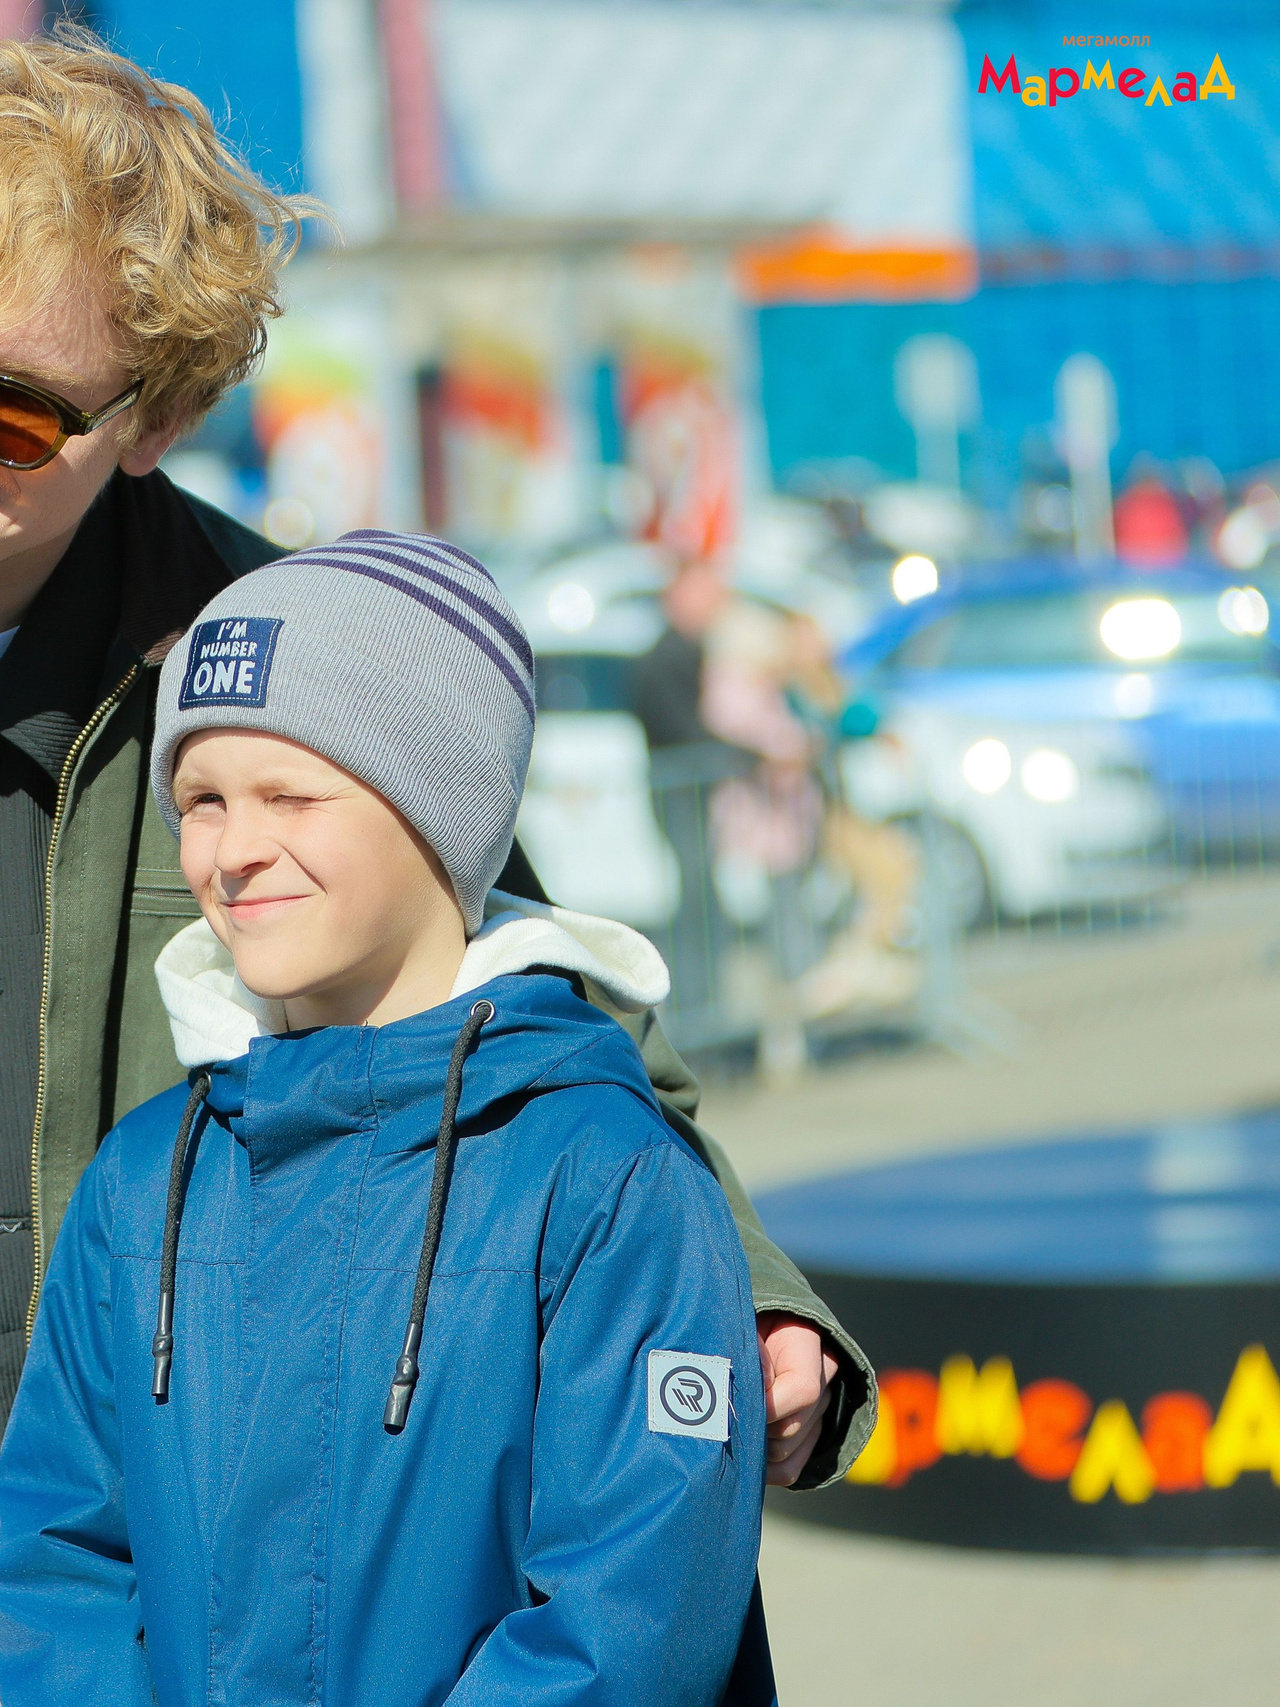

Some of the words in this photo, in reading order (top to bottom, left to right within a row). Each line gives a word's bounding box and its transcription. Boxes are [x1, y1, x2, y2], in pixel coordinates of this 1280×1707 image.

[216, 620, 248, 640] I'M
[200, 641, 258, 659] NUMBER
[193, 660, 256, 695] ONE
